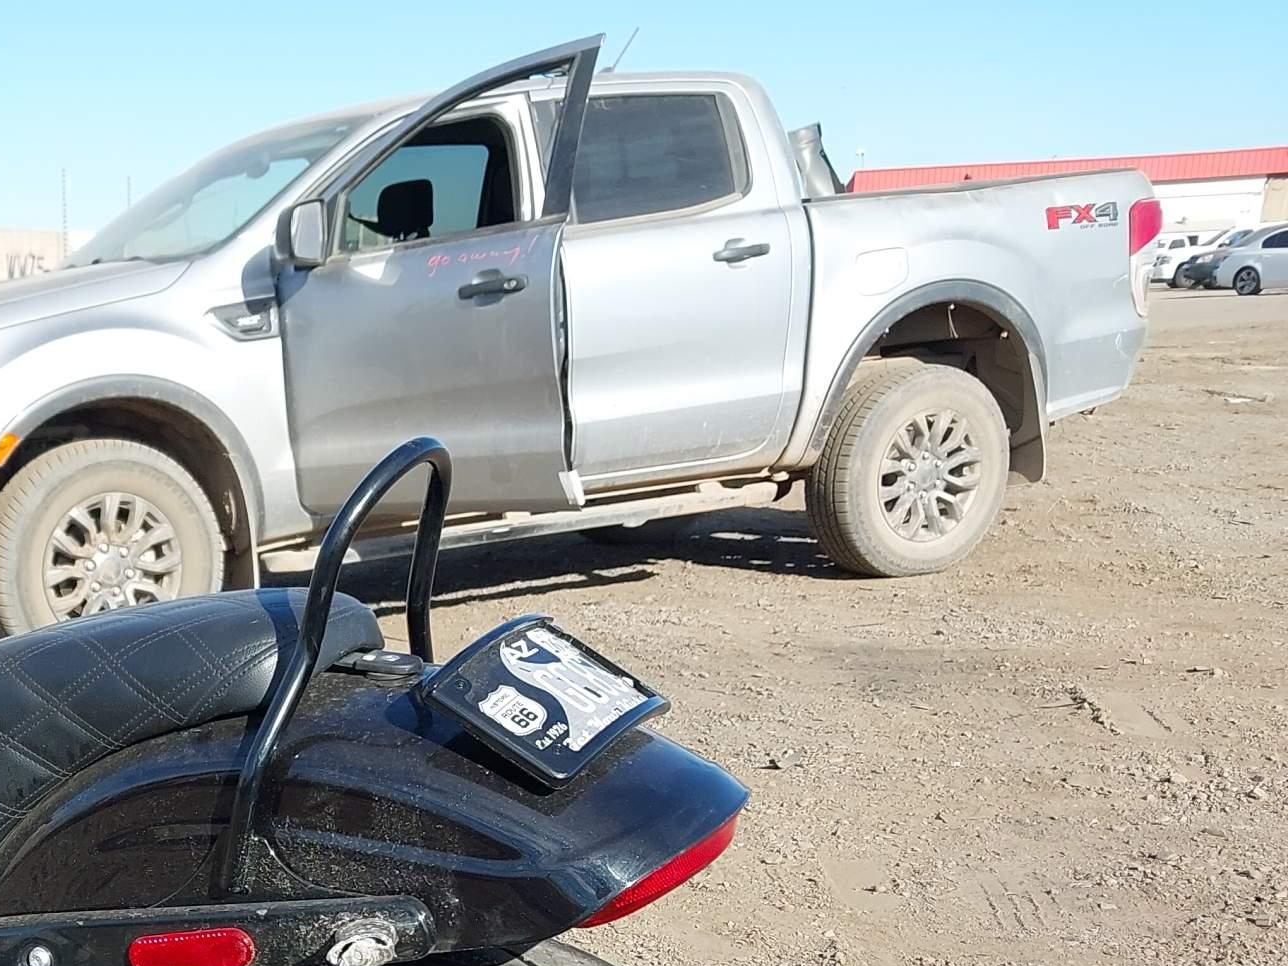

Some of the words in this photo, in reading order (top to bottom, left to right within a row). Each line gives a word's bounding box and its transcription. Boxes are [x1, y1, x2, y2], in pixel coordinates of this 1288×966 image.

[1045, 201, 1118, 230] FX4
[426, 254, 451, 277] go
[504, 639, 539, 665] AZ
[501, 700, 524, 719] ROUTE
[511, 707, 539, 729] 66
[546, 722, 569, 740] 1926
